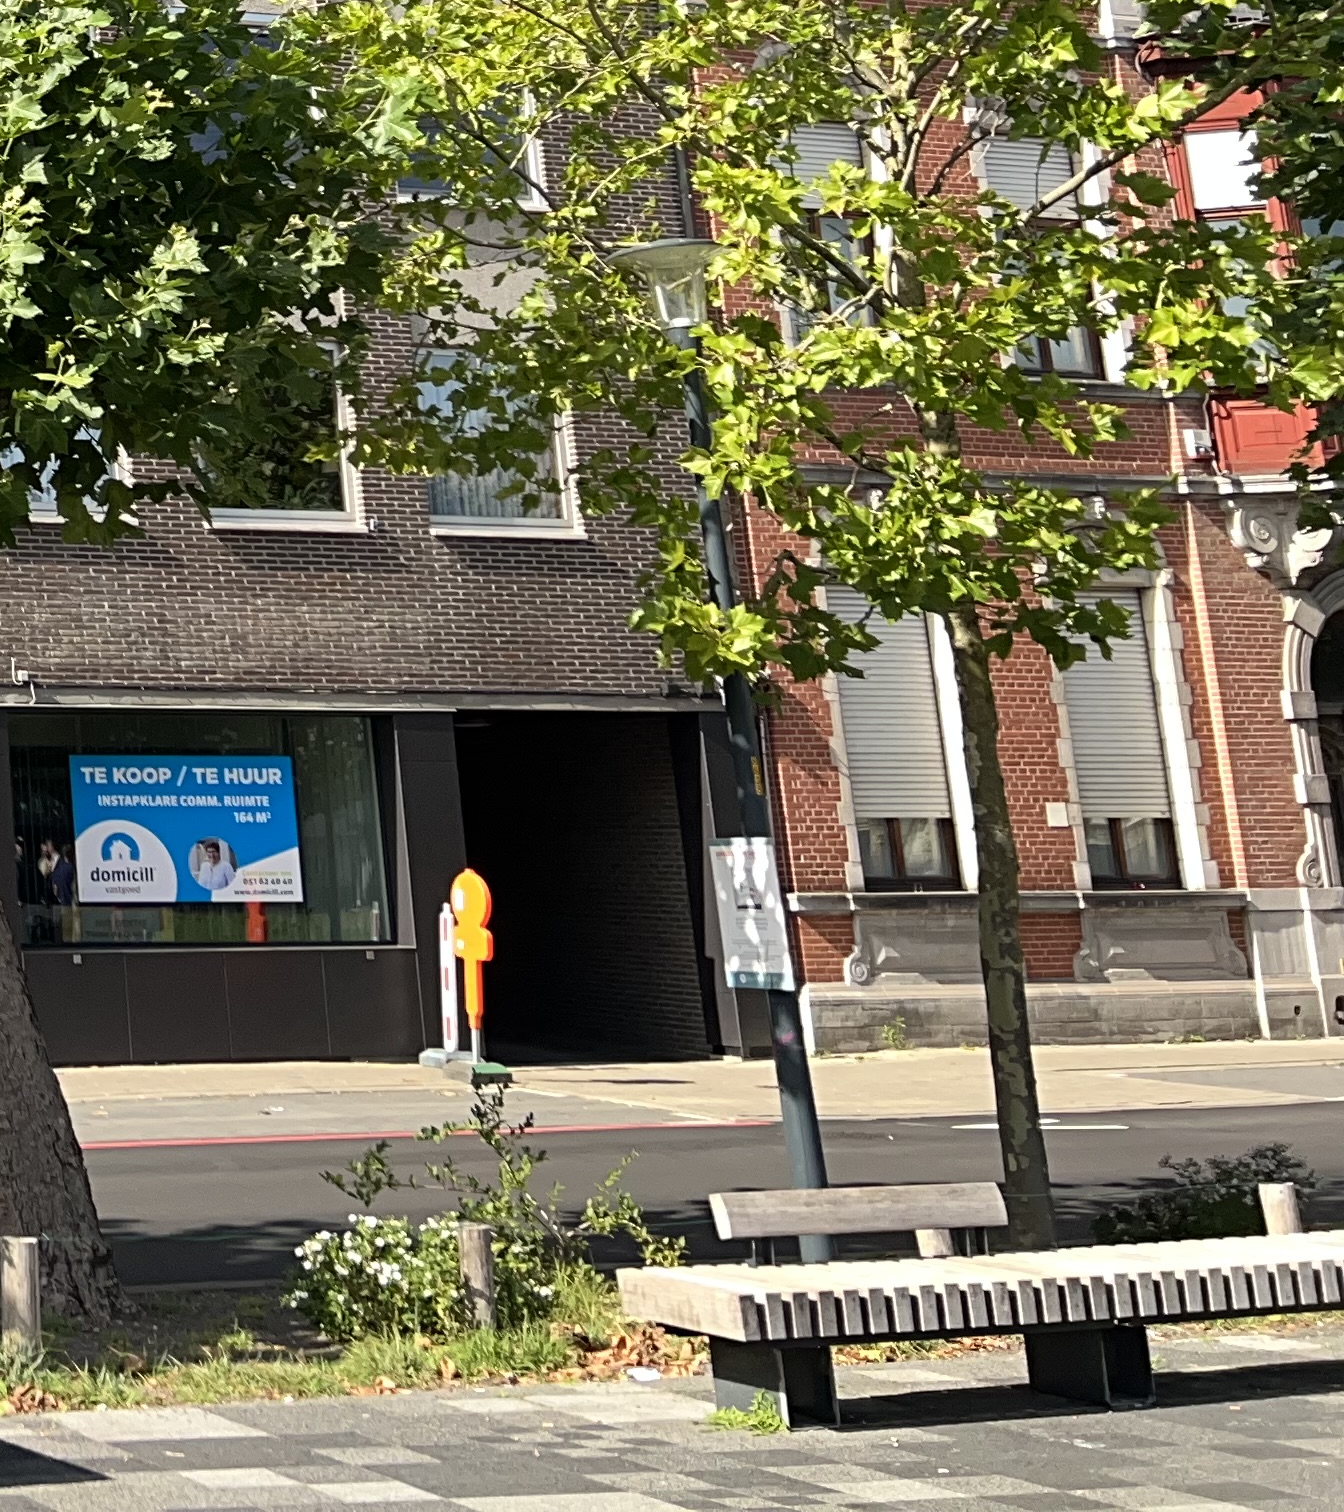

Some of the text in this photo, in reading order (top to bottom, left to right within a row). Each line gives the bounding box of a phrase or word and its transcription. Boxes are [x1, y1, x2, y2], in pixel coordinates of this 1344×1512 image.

[80, 766, 283, 787] TE KOOP / TE HUUR
[98, 794, 270, 807] INSTAPKLARE COMM. RUIMTE
[234, 811, 254, 824] 164
[90, 867, 154, 883] domicill
